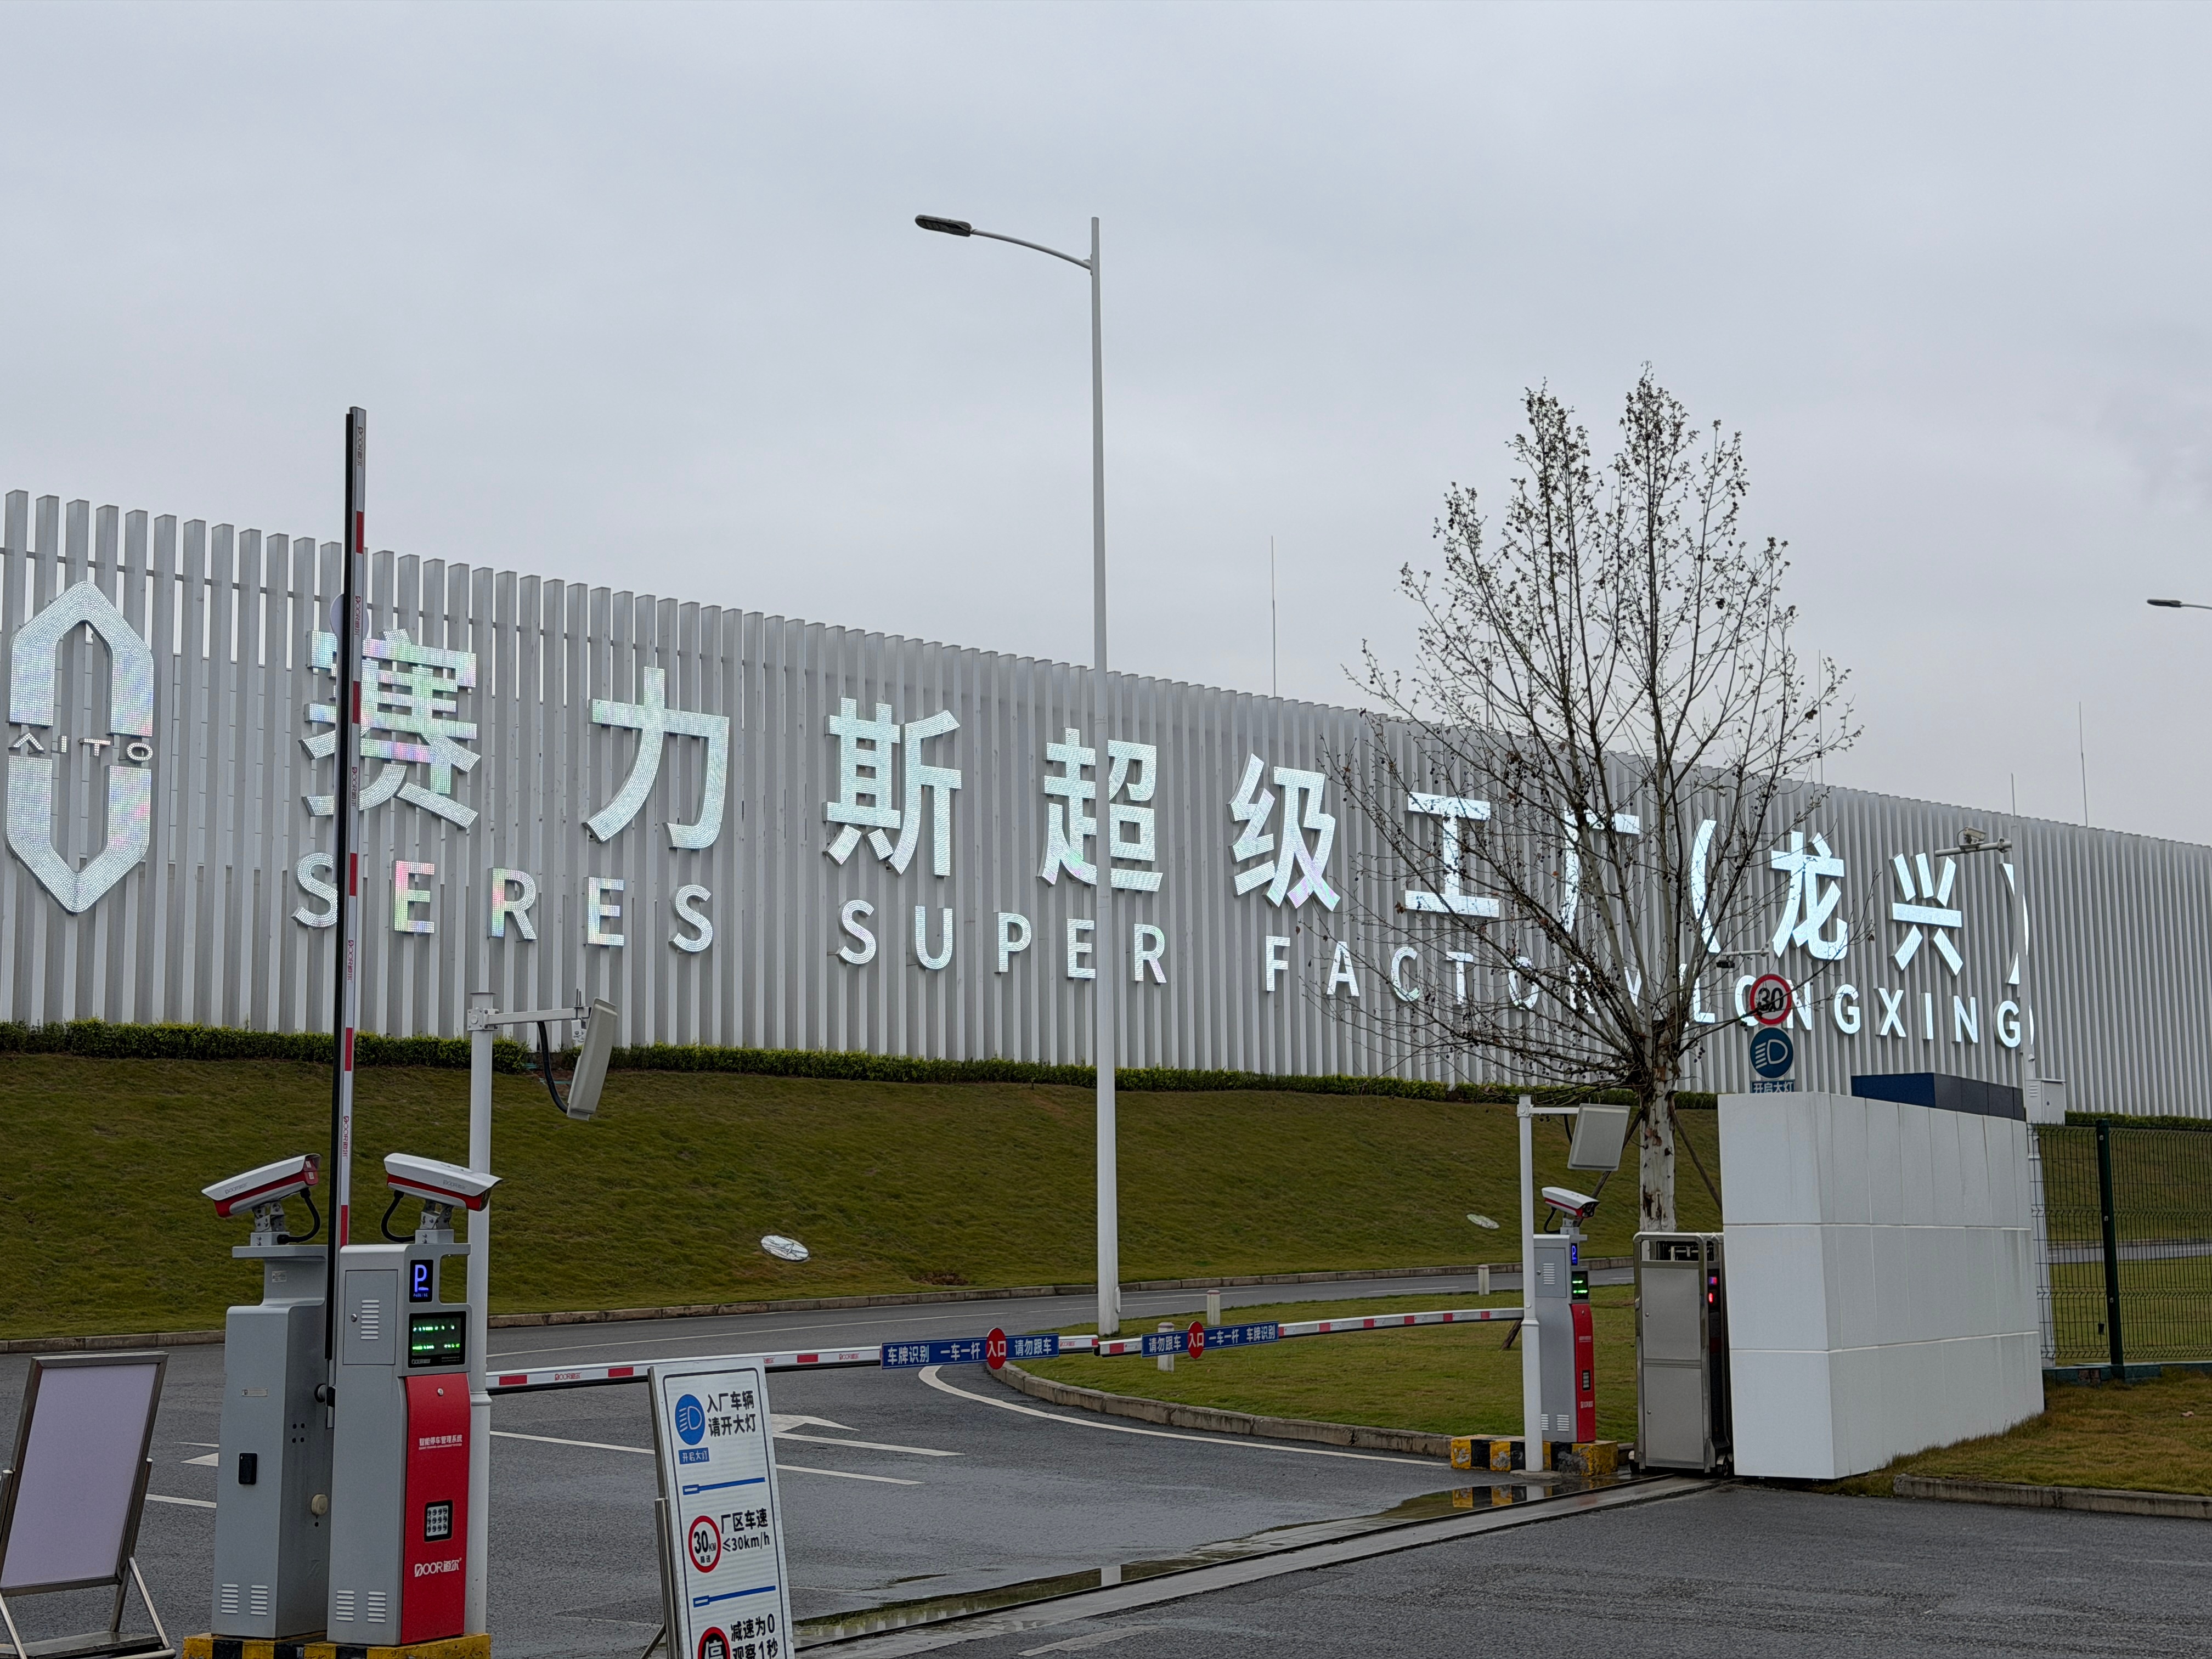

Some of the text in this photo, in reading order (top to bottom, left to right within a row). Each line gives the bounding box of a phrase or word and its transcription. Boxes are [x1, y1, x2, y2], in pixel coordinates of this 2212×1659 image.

[13, 732, 153, 761] AITO
[292, 853, 713, 953] SERES
[837, 899, 1167, 984] SUPER
[1758, 987, 1784, 1011] 30
[1753, 1081, 1793, 1093] 开启大灯
[415, 1265, 427, 1293] P
[887, 1338, 1052, 1365] 车牌识别 一车一杆 入口 请勿跟车
[1149, 1324, 1276, 1353] 请勿跟车 入口 一车一杆 车牌识别
[707, 1390, 755, 1413] 入厂车辆
[708, 1413, 756, 1437] 请开大灯
[682, 1450, 708, 1463] 开启大灯
[720, 1508, 769, 1534] 厂区车速
[730, 1613, 775, 1642] 减速为0
[732, 1637, 778, 1659] 观察1秒
